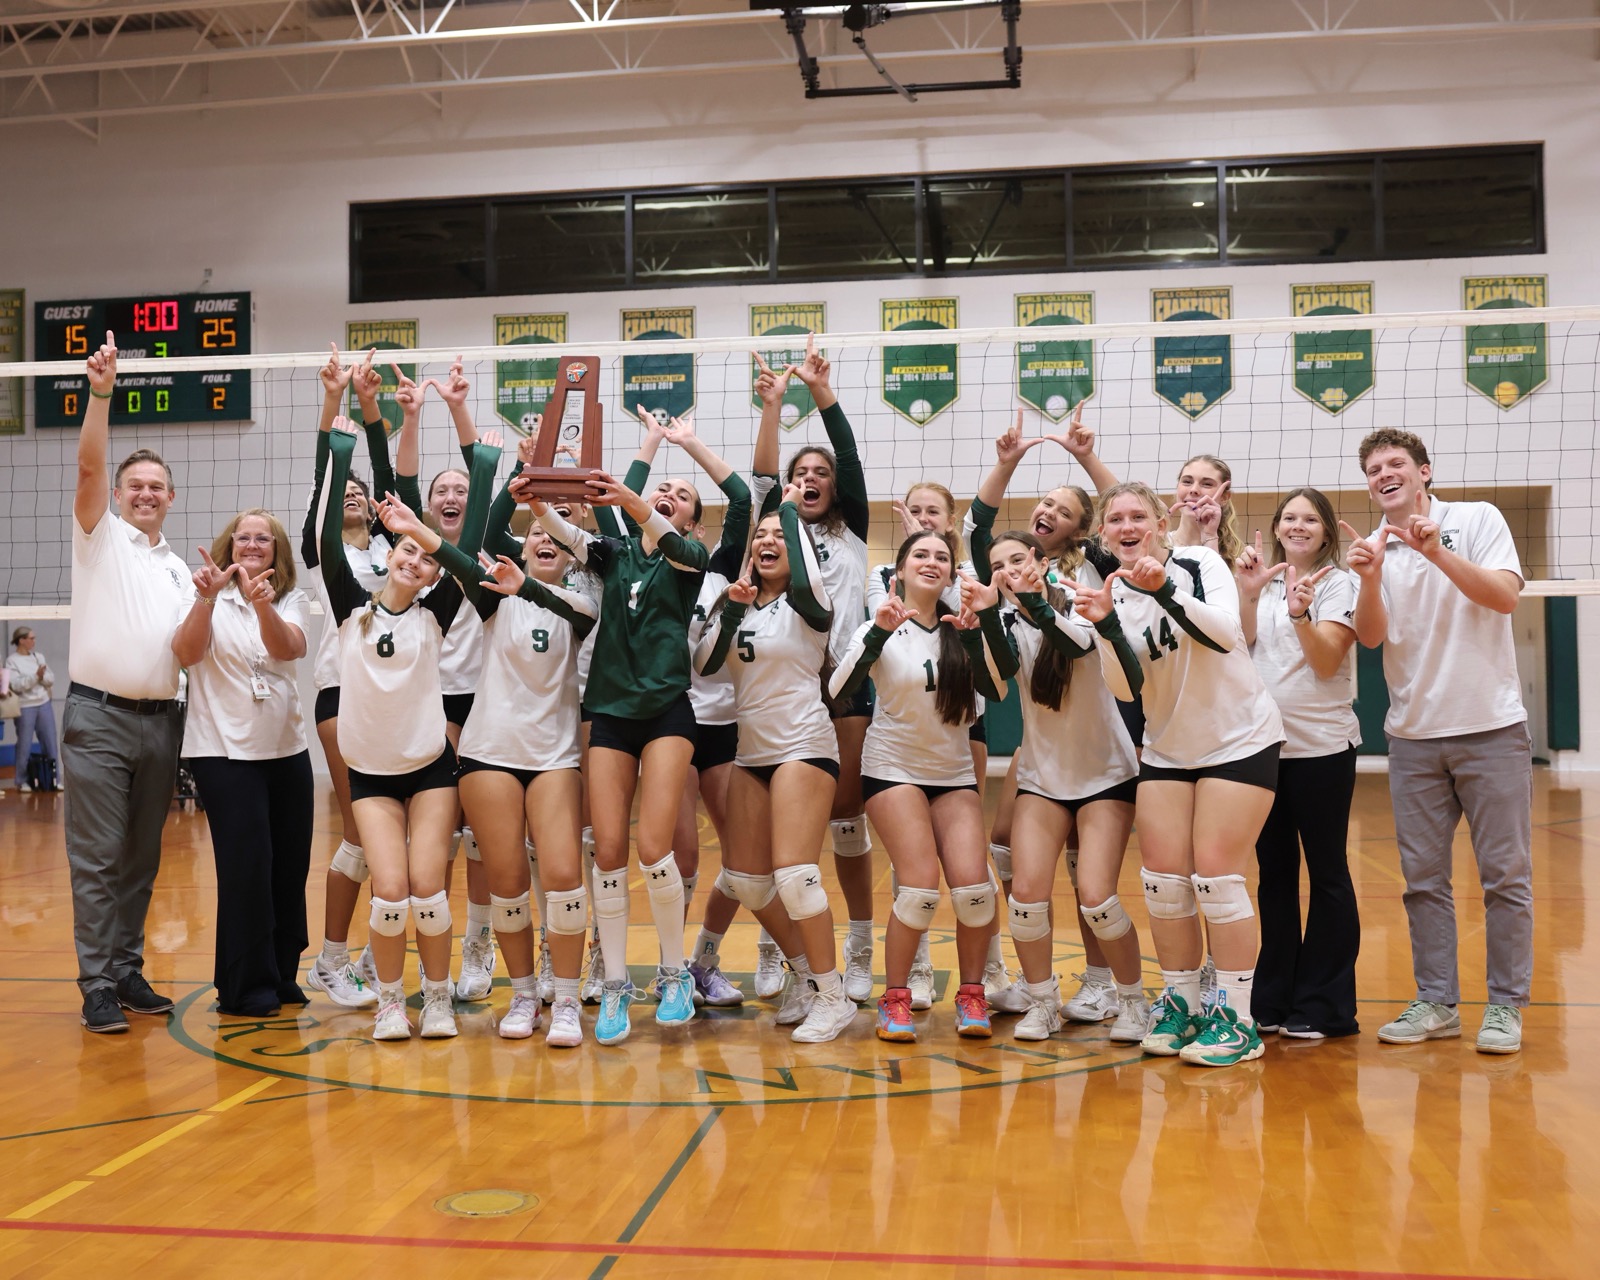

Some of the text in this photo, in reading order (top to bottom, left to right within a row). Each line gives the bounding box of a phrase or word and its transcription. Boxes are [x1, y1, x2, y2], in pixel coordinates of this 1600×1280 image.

[1468, 278, 1542, 286] SOFTBALL
[194, 299, 239, 313] HOME
[1295, 292, 1370, 317] CHAMPIONS
[1467, 286, 1543, 310] CHAMPIONS
[44, 306, 92, 320] GUEST
[134, 301, 179, 332] 1:00
[885, 308, 955, 331] CHAMPIONS
[1019, 302, 1090, 326] CHAMPIONS
[1155, 298, 1229, 322] CHAMPIONS
[203, 318, 236, 348] 25
[498, 323, 565, 346] CHAMPIONS
[625, 318, 692, 341] CHAMPIONS
[753, 312, 823, 336] CHAMPIONS
[65, 325, 88, 354] 15
[350, 329, 415, 351] CHAMPIONS
[54, 380, 83, 389] FOULS
[114, 376, 174, 386] LAYER-FOUL
[201, 374, 232, 384] FOULS
[64, 394, 78, 416] 0
[128, 390, 169, 412] 0 0
[212, 388, 226, 410] 2
[628, 580, 642, 610] 1
[532, 628, 549, 652] 9
[738, 630, 756, 662] 5
[1142, 615, 1179, 662] 14
